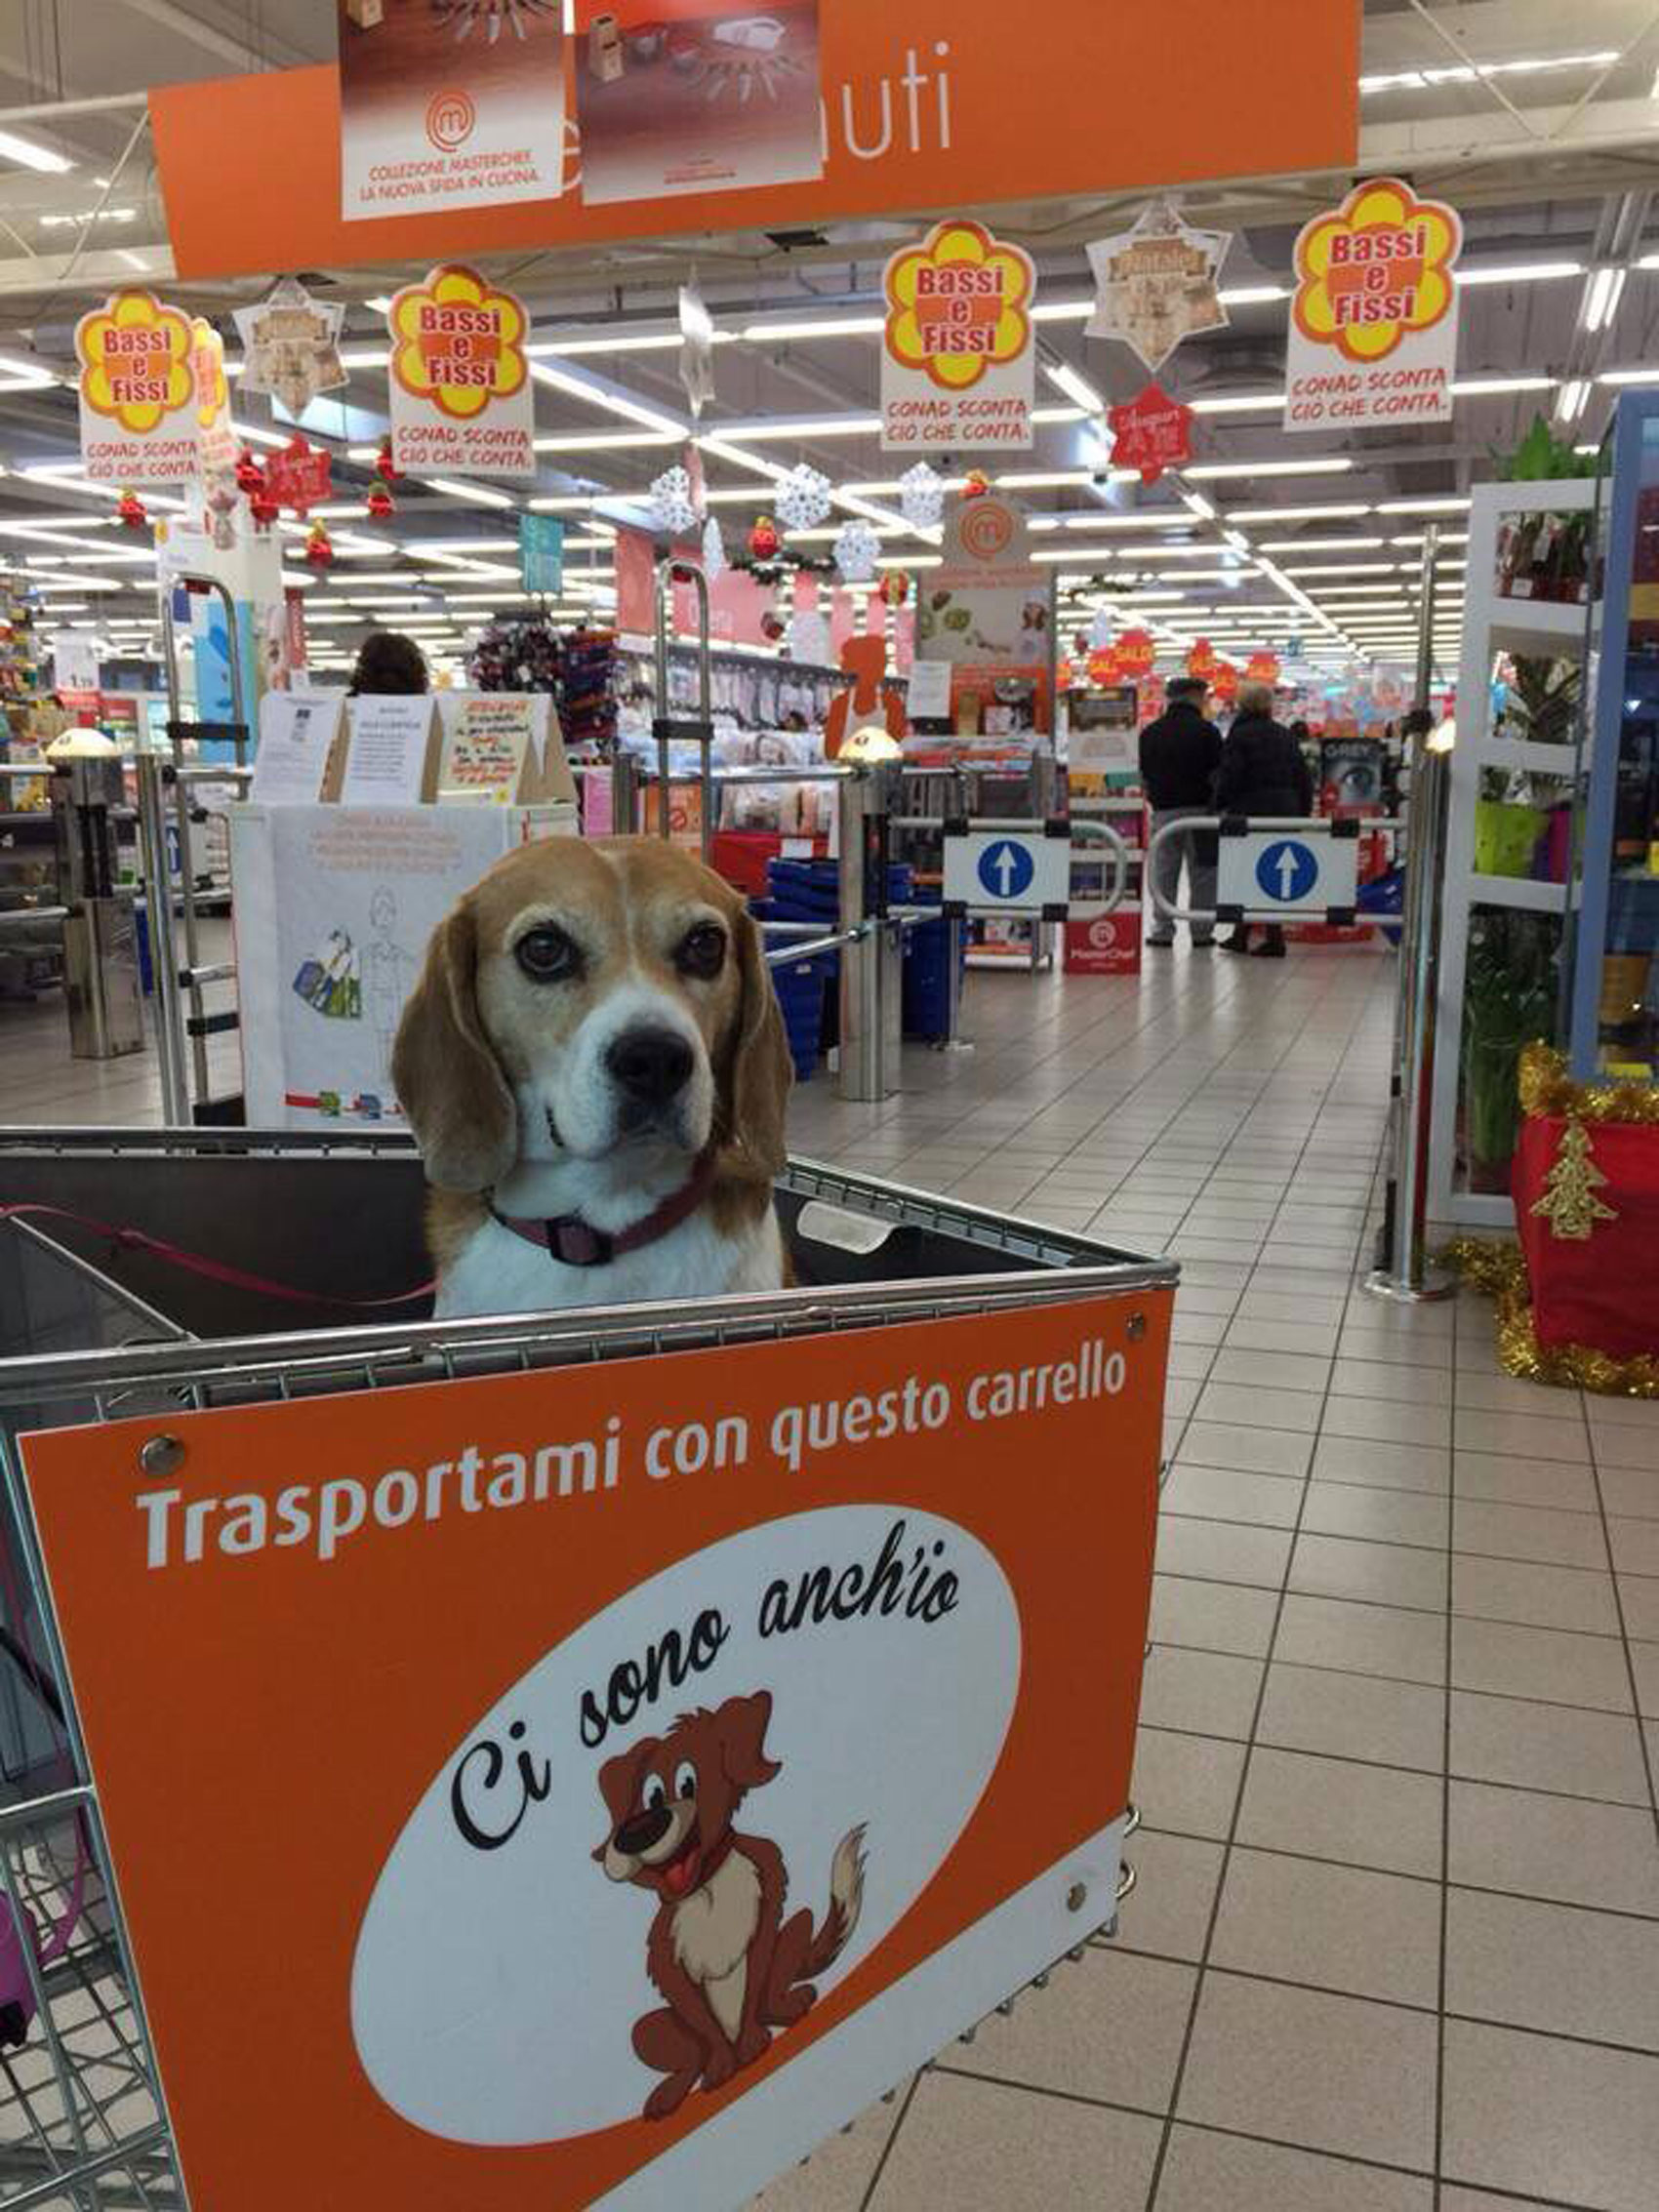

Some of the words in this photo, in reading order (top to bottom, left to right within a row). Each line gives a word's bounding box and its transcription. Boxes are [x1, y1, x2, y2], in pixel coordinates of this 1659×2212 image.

[368, 160, 444, 181] COLLEZIONE
[1331, 225, 1427, 262] Bassi
[917, 265, 1003, 295] Bassi
[1366, 266, 1386, 290] e
[420, 305, 502, 334] Bassi
[951, 302, 968, 323] e
[1335, 291, 1414, 325] Fissi
[103, 329, 172, 353] Bassi
[453, 338, 469, 358] e
[923, 327, 995, 352] Fissi
[132, 357, 146, 377] e
[429, 359, 496, 385] Fissi
[112, 379, 170, 402] Fissi
[1291, 374, 1361, 395] CONAD
[1367, 367, 1446, 391] SCONTA
[887, 400, 951, 419] CONAD
[957, 398, 1027, 418] SCONTA
[1328, 399, 1365, 418] CHE
[397, 426, 457, 444] CONAD
[464, 428, 530, 446] SCONTA
[923, 423, 957, 440] CHE
[87, 443, 139, 458] CONAD
[144, 441, 198, 458] SCONTA
[432, 448, 465, 464] CHE
[117, 461, 145, 476] CHE
[136, 1416, 622, 1569] Trasportami
[644, 1415, 749, 1479] con
[770, 1376, 951, 1472] questo
[966, 1339, 1127, 1421] carrello
[451, 1720, 551, 1852] Ci
[579, 1608, 731, 1749] sono
[757, 1519, 959, 1639] anch'io
